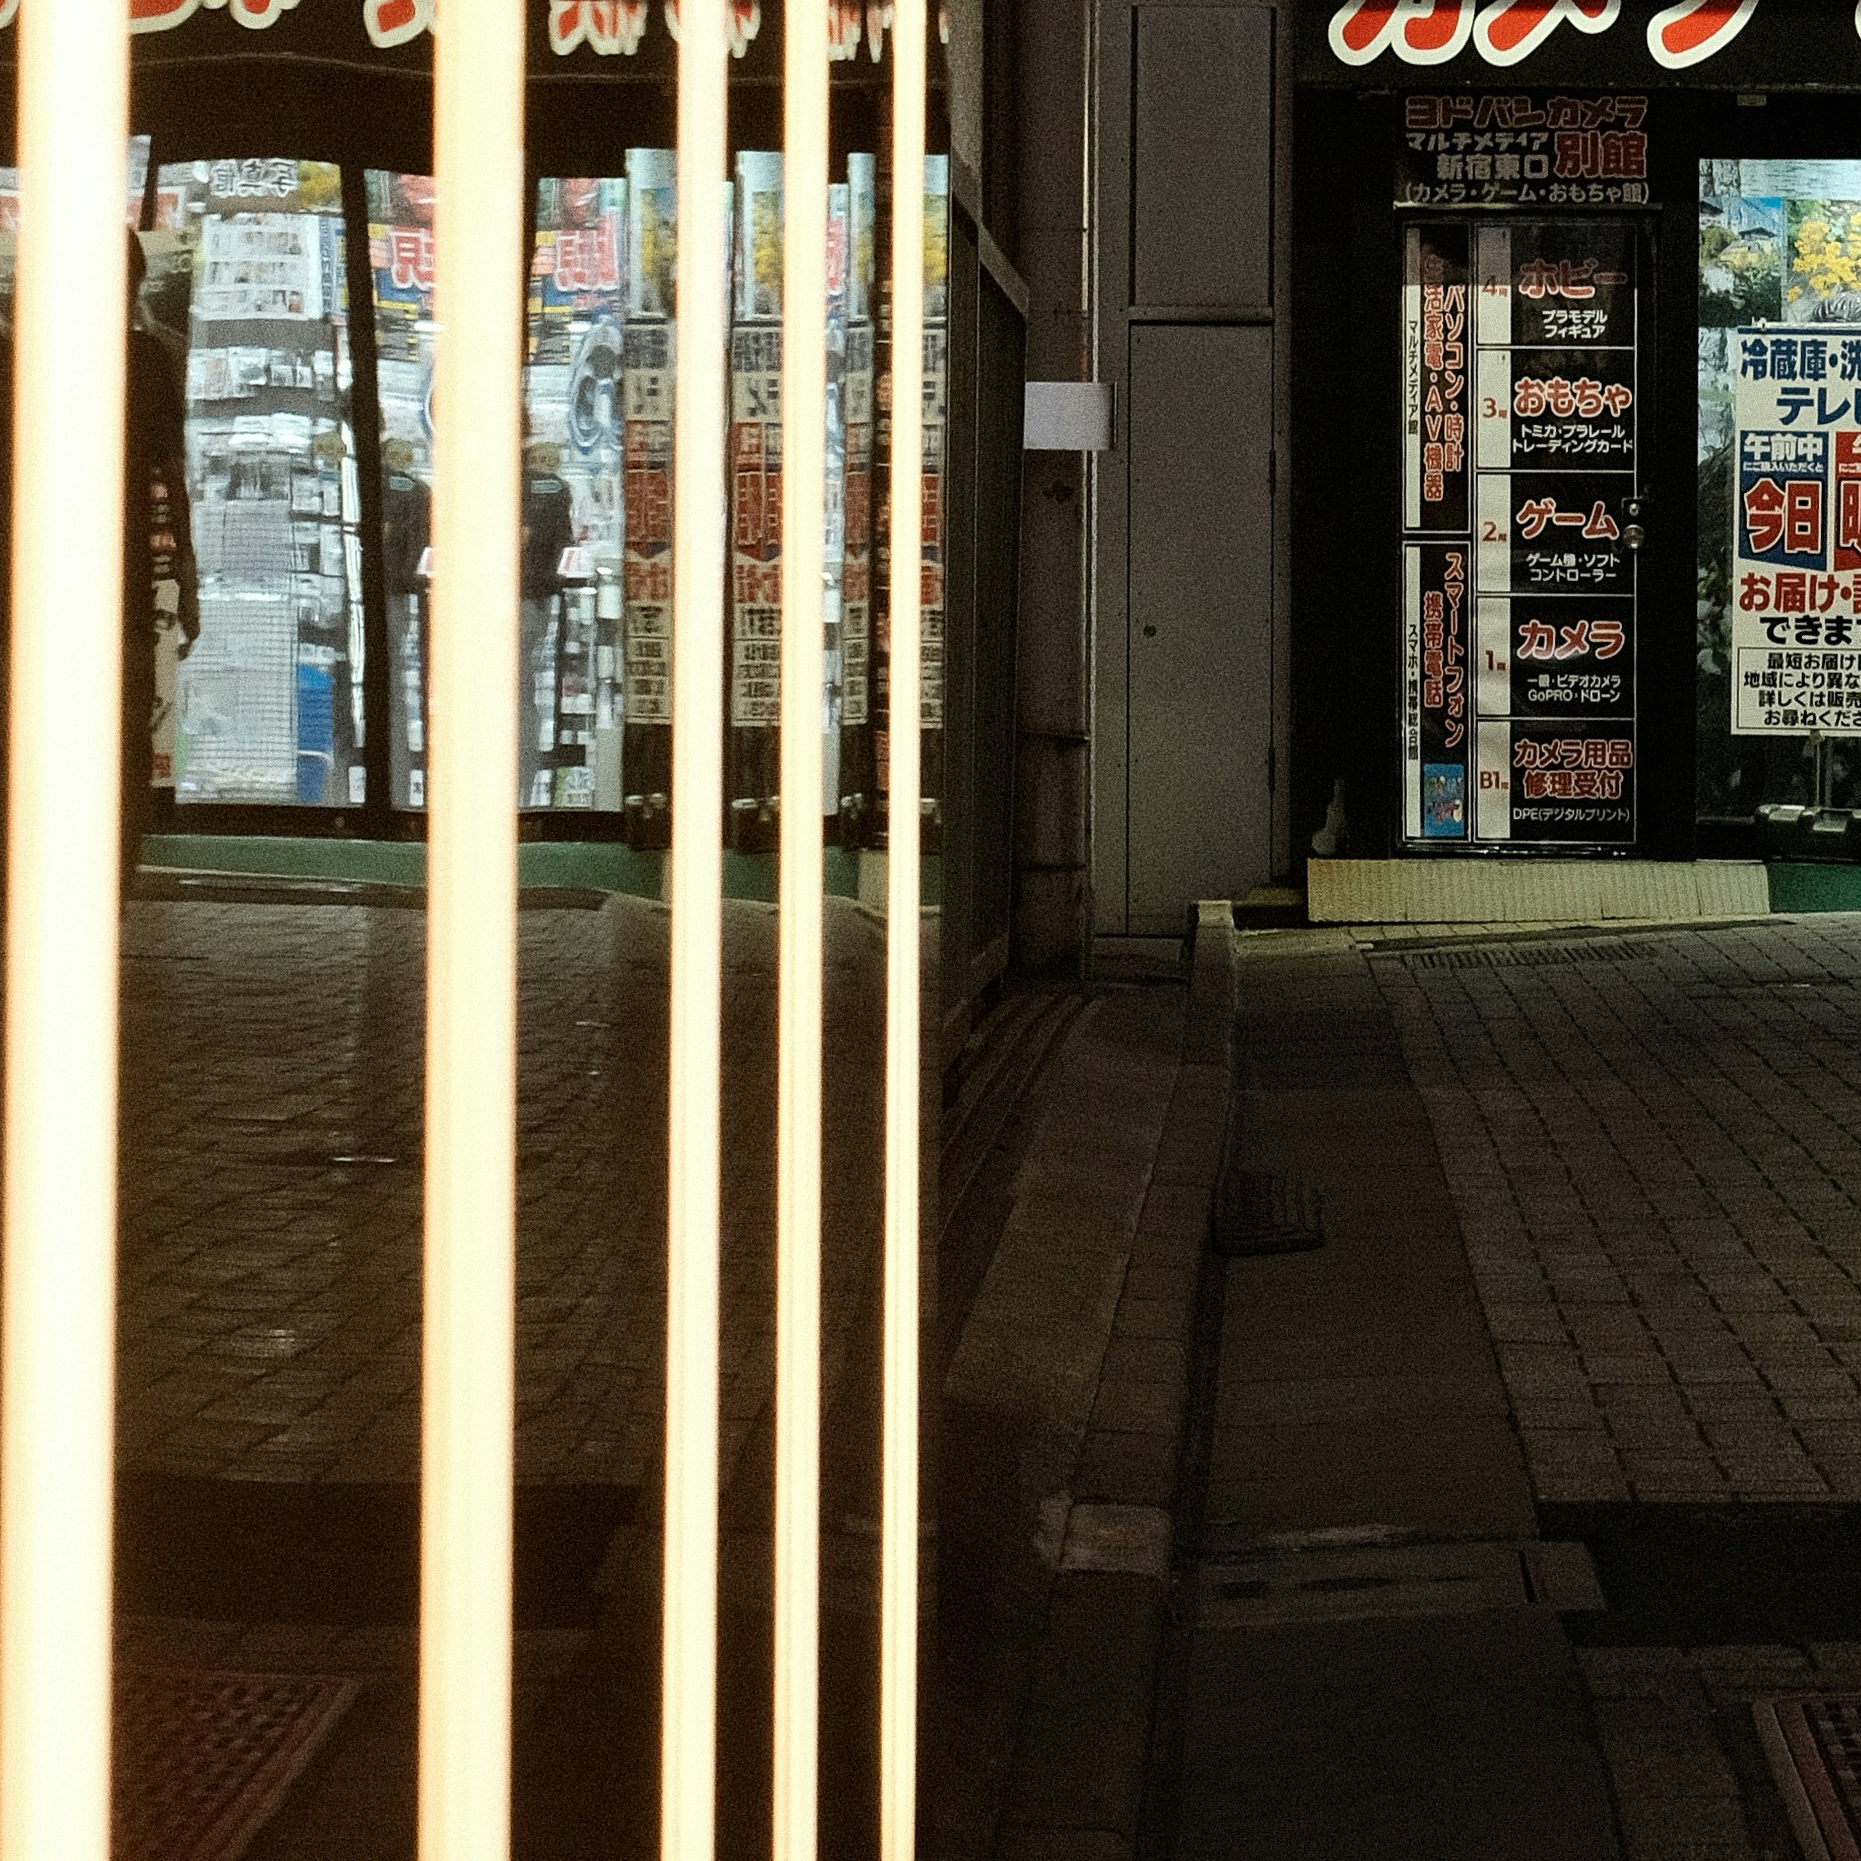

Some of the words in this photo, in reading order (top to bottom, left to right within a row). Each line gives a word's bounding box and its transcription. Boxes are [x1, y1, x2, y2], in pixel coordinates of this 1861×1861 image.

[1405, 95, 1648, 129] ヨドバシカメラ
[1405, 132, 1549, 151] マルチメディア
[1554, 130, 1647, 179] 別館
[1436, 154, 1549, 179] 新宿東口
[1518, 258, 1628, 299] ホビー
[1541, 309, 1608, 325] プラモデル
[1544, 325, 1606, 340] フィギュア
[1407, 320, 1419, 436] マルチメディア館
[1444, 284, 1465, 472] パソコン・時計
[1514, 376, 1632, 417] おもちゃ
[1511, 438, 1634, 455] トレーディングカード
[1520, 423, 1626, 439] トミカ・プラレール
[1743, 433, 1825, 462] 午前中
[1516, 497, 1620, 541] ゲーム
[1744, 477, 1824, 556] 今日
[1529, 568, 1617, 583] コントローラー
[1424, 591, 1444, 708] 携帯電話
[1444, 552, 1464, 748] スマートフォン
[1517, 619, 1625, 660] カメラ
[1513, 739, 1633, 768] カメラ用品
[1522, 769, 1624, 799] 修理受付
